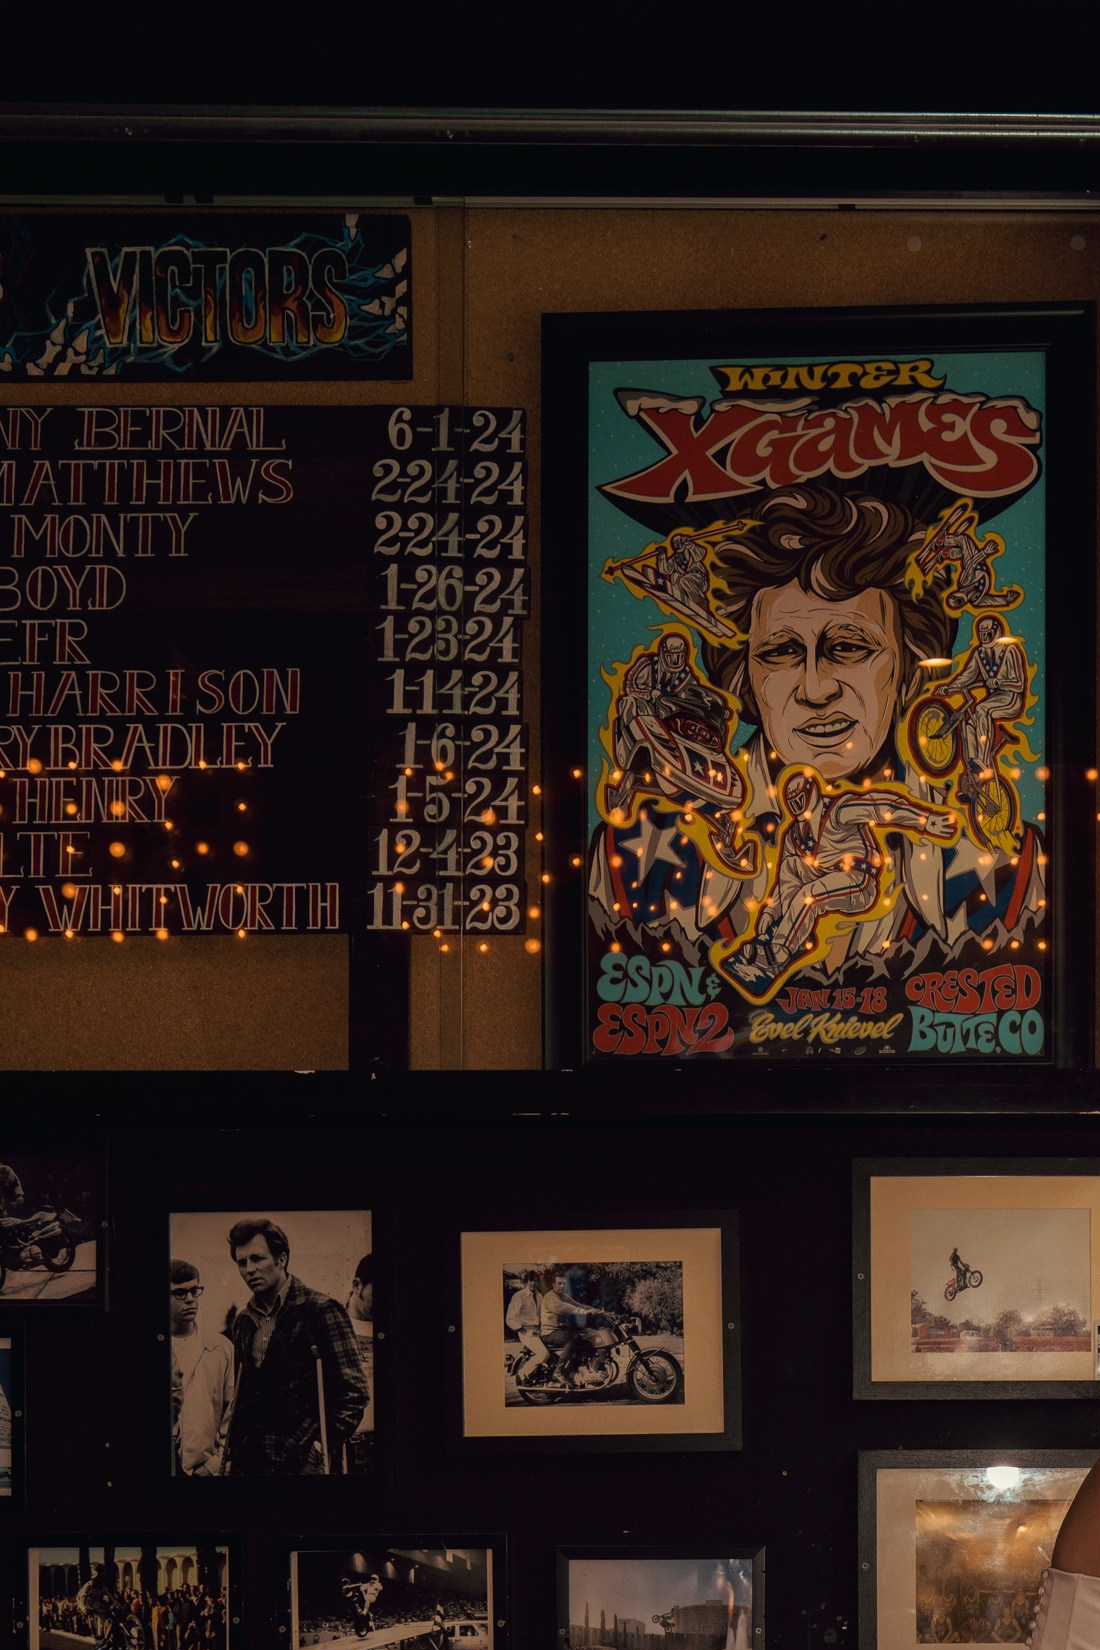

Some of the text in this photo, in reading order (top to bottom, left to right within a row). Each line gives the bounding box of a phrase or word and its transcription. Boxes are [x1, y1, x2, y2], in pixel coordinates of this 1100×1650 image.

[85, 246, 350, 347] VICTORS
[74, 407, 286, 451] BERNAL
[388, 407, 524, 451] 6-1-24
[371, 459, 525, 506] 2-24-24
[11, 511, 525, 560] MONTY 2-24-24
[379, 564, 528, 615] 1-26-24
[375, 616, 520, 663] 1-23-24
[7, 669, 521, 716] HARRISON 1-14-24
[46, 723, 286, 770] BRADLEY
[397, 721, 525, 771] 1-6-24
[12, 775, 525, 825] HENRY 1-5-24
[372, 829, 520, 877] 12-4-23
[34, 883, 339, 931] WHITWORTH
[367, 883, 521, 931] 11-31-23
[596, 951, 706, 1006] ESPN
[775, 986, 888, 1015] JAN 15-18
[905, 963, 1043, 1014] CRESTED
[592, 1002, 735, 1056] ESPN2
[749, 1012, 904, 1046] Evel Knievel
[998, 1009, 1045, 1056] CO
